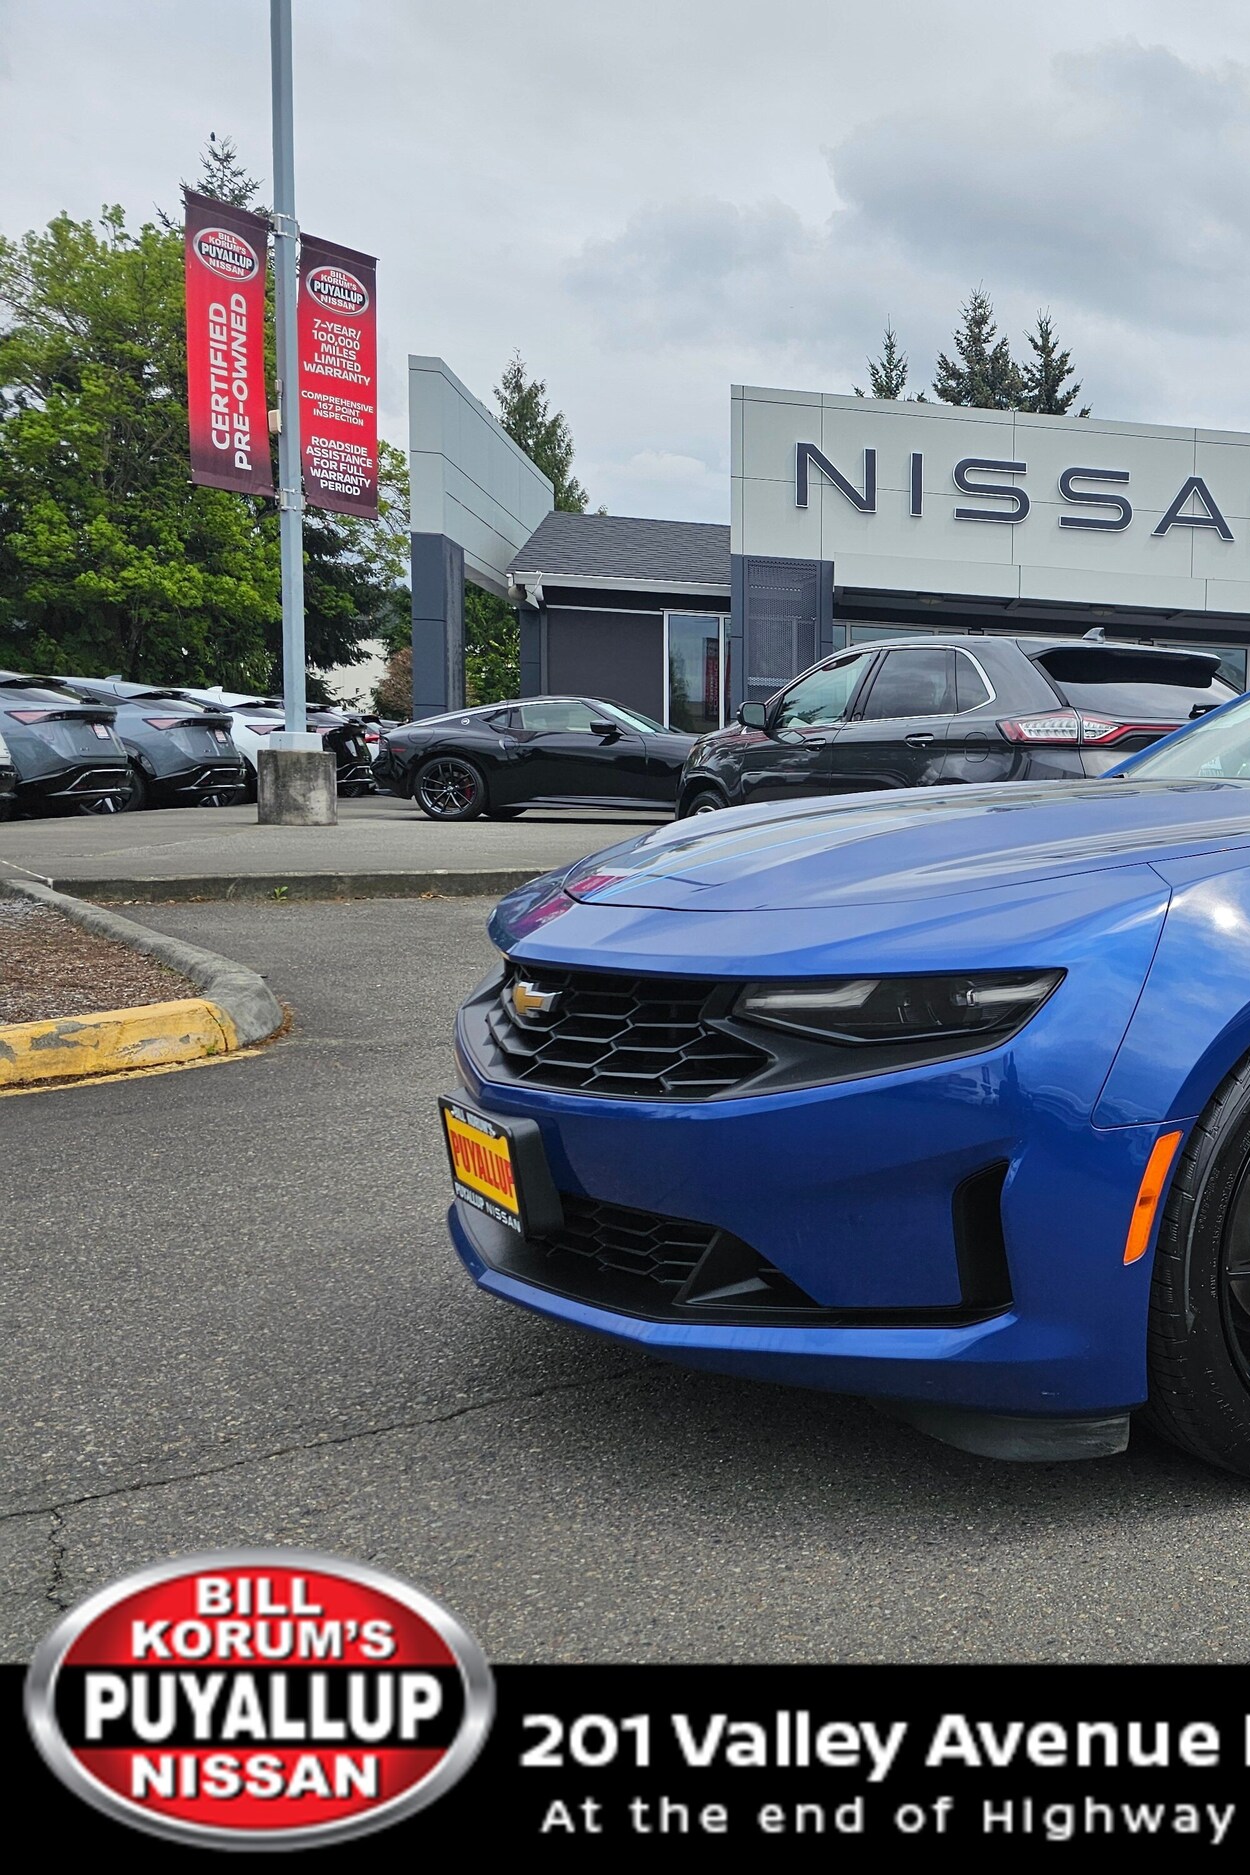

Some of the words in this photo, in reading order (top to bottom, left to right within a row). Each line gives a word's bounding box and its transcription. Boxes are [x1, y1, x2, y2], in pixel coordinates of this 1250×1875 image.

[208, 235, 247, 255] KORUM'S
[219, 232, 237, 245] BILL
[201, 242, 253, 269] PUYALLUP
[209, 258, 245, 276] NISSAN
[330, 270, 348, 282] BILL
[314, 280, 363, 304] PUYALLUP
[320, 274, 357, 291] KORUM'S
[320, 294, 355, 311] NISSAN
[312, 329, 360, 351] 100,000
[313, 318, 361, 341] 7-YEAR/
[314, 352, 361, 373] LIMITED
[321, 343, 357, 361] MILES
[209, 302, 230, 451] CERTIFIED
[231, 292, 252, 471] PRE-OWNED
[303, 361, 371, 386] WARRANTY
[301, 390, 374, 414] COMPREHENSIVE
[317, 402, 334, 412] 167
[335, 405, 360, 418] POINT
[313, 408, 364, 427] INSPECTION
[306, 445, 373, 468] ASSISTANCE
[311, 435, 368, 457] ROADSIDE
[310, 466, 371, 489] WARRANTY
[313, 457, 338, 471] FOR
[340, 462, 366, 477] FULL
[320, 479, 361, 496] PERIOD
[450, 1128, 515, 1199] PUYALLUP
[485, 1201, 522, 1233] NISSAN
